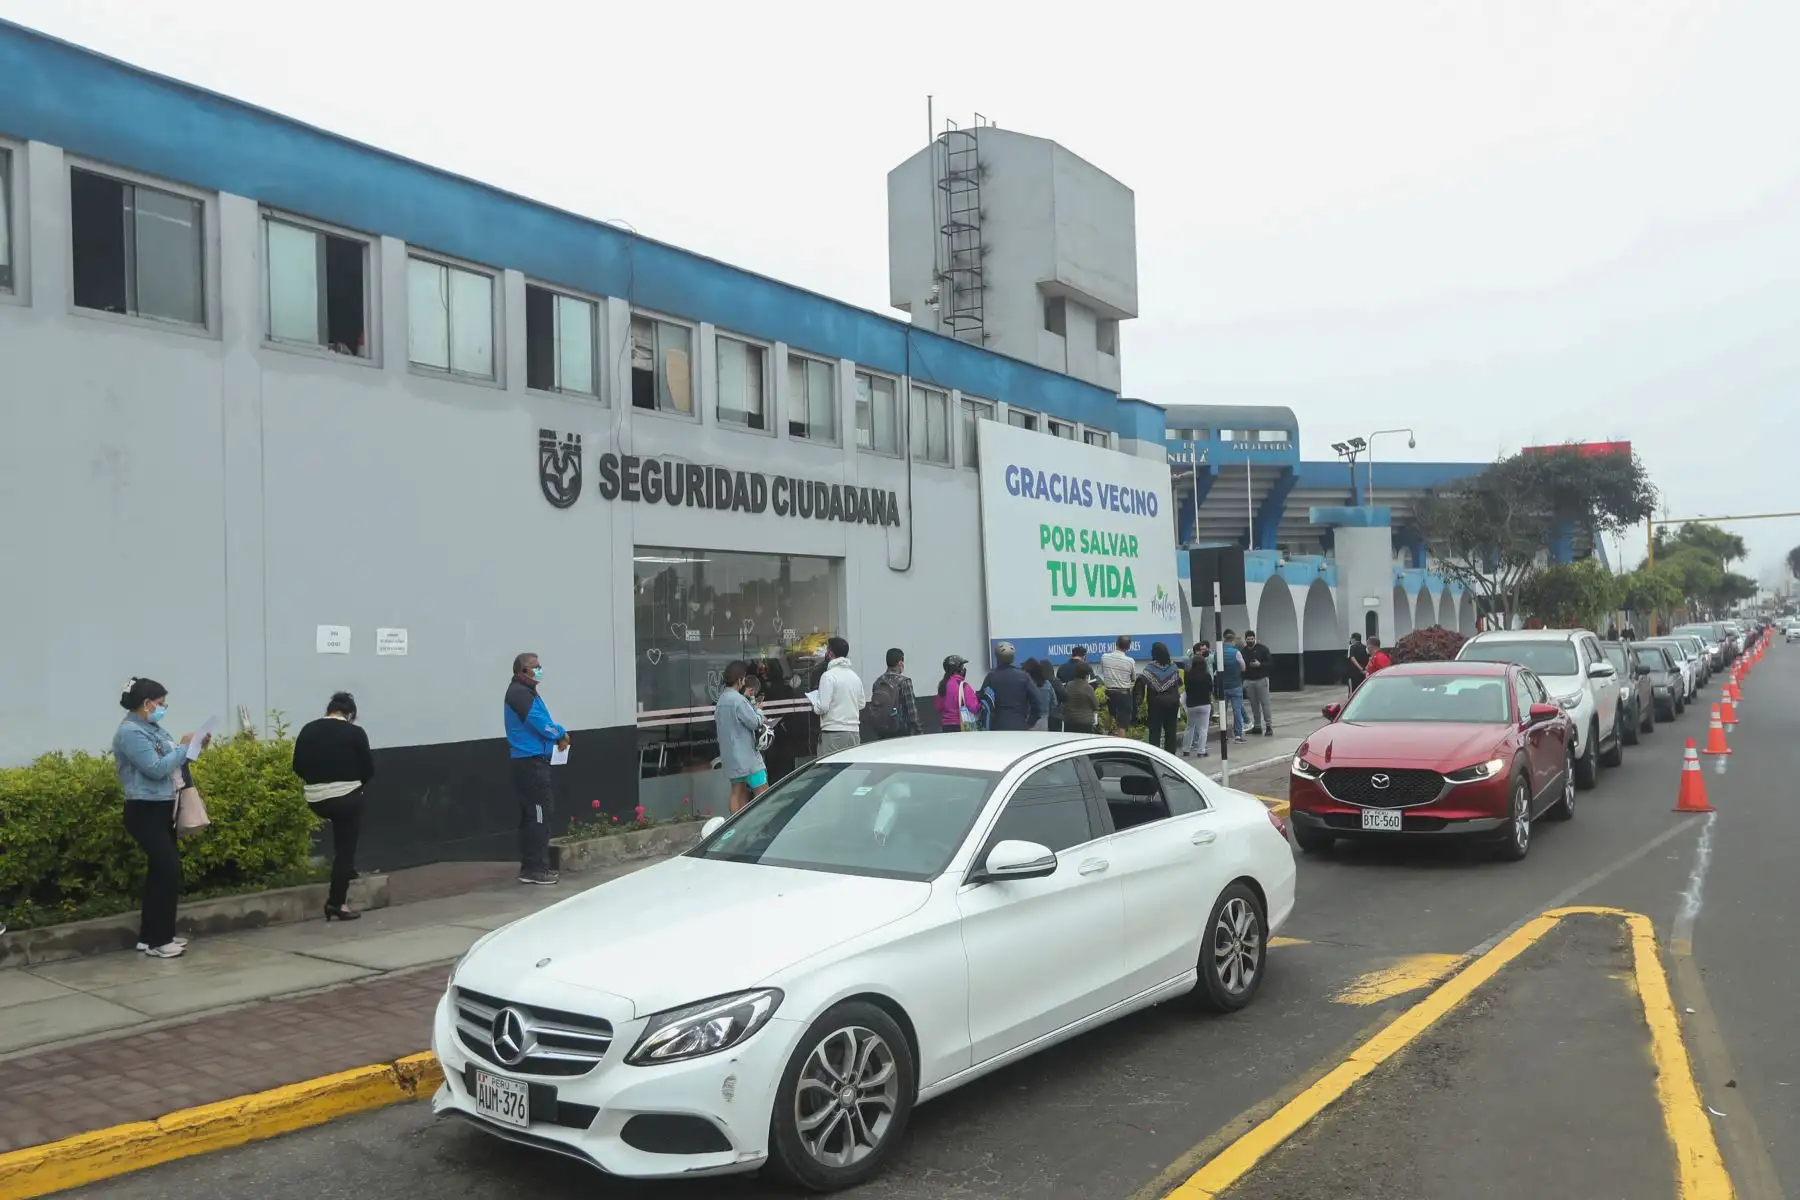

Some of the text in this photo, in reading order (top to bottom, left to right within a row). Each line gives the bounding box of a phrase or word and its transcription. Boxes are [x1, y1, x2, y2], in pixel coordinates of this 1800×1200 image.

[598, 452, 901, 528] SEGURIDAD CIUDADANA
[1005, 464, 1158, 518] GRACIAS VECINO
[1040, 524, 1138, 558] POR SALVAR
[1046, 560, 1136, 599] TU VIDA
[1048, 642, 1098, 656] MUNICIIDAD
[1098, 642, 1107, 653] DE
[1364, 815, 1400, 827] BTC-560
[491, 1077, 510, 1090] PERU
[479, 1084, 525, 1119] AUM-376
